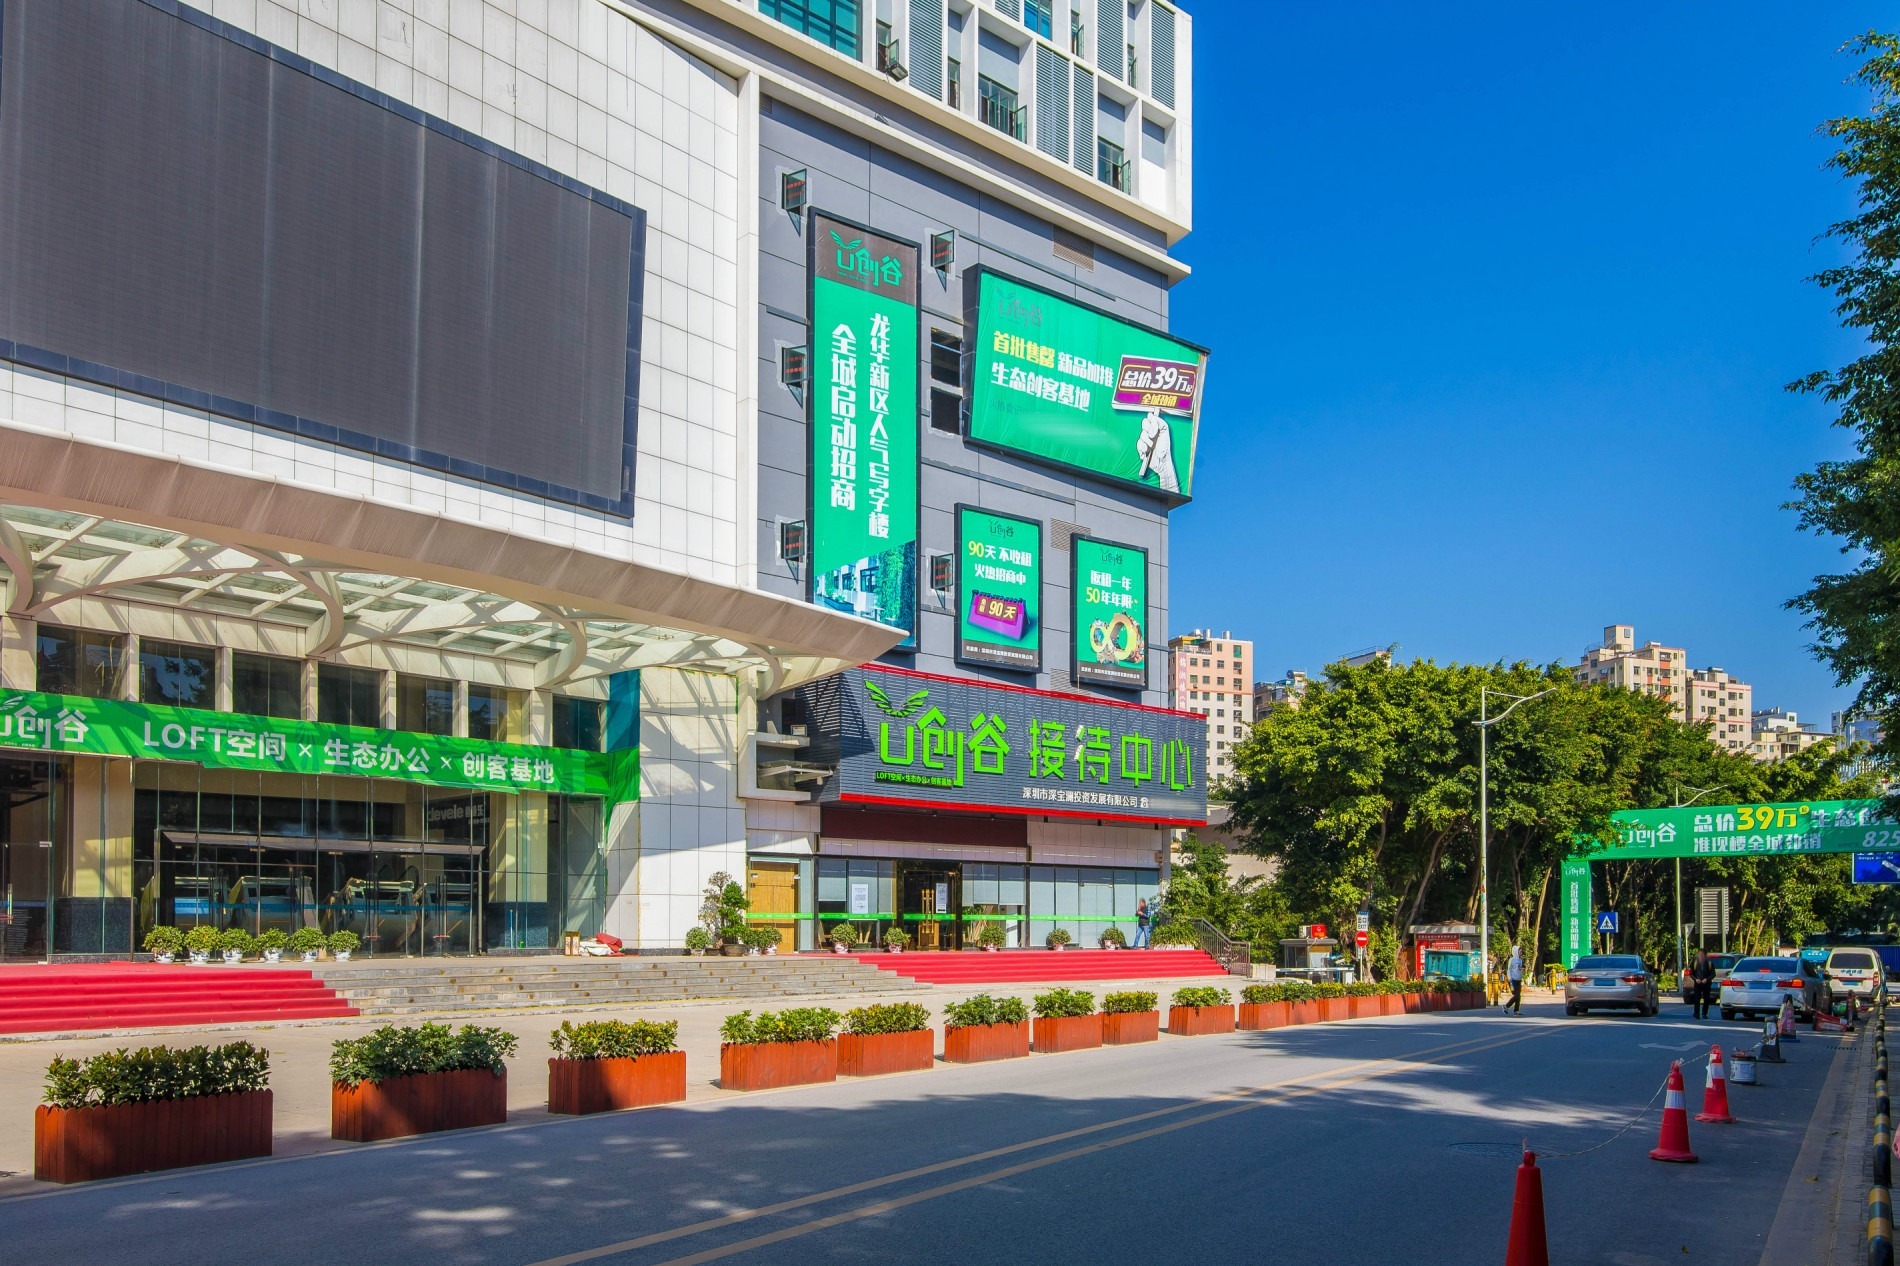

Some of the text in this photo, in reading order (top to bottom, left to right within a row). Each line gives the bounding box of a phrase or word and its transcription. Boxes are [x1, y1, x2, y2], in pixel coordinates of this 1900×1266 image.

[993, 330, 1114, 388] 首批售罄 新品加推
[990, 361, 1091, 412] 生态创客基地
[831, 323, 857, 511] 全城启动招商
[868, 312, 891, 539] 龙华新区人气写字楼
[968, 540, 1032, 567] 90天 不收租
[974, 563, 1027, 586] 火热招商中
[988, 600, 1017, 619] 90天
[143, 720, 286, 762] LOFT空间
[323, 738, 430, 774] 生态办公
[462, 751, 556, 785] 创客基地
[1028, 718, 1193, 791] 接待中心
[1693, 832, 1822, 853] 准现楼全城劲销
